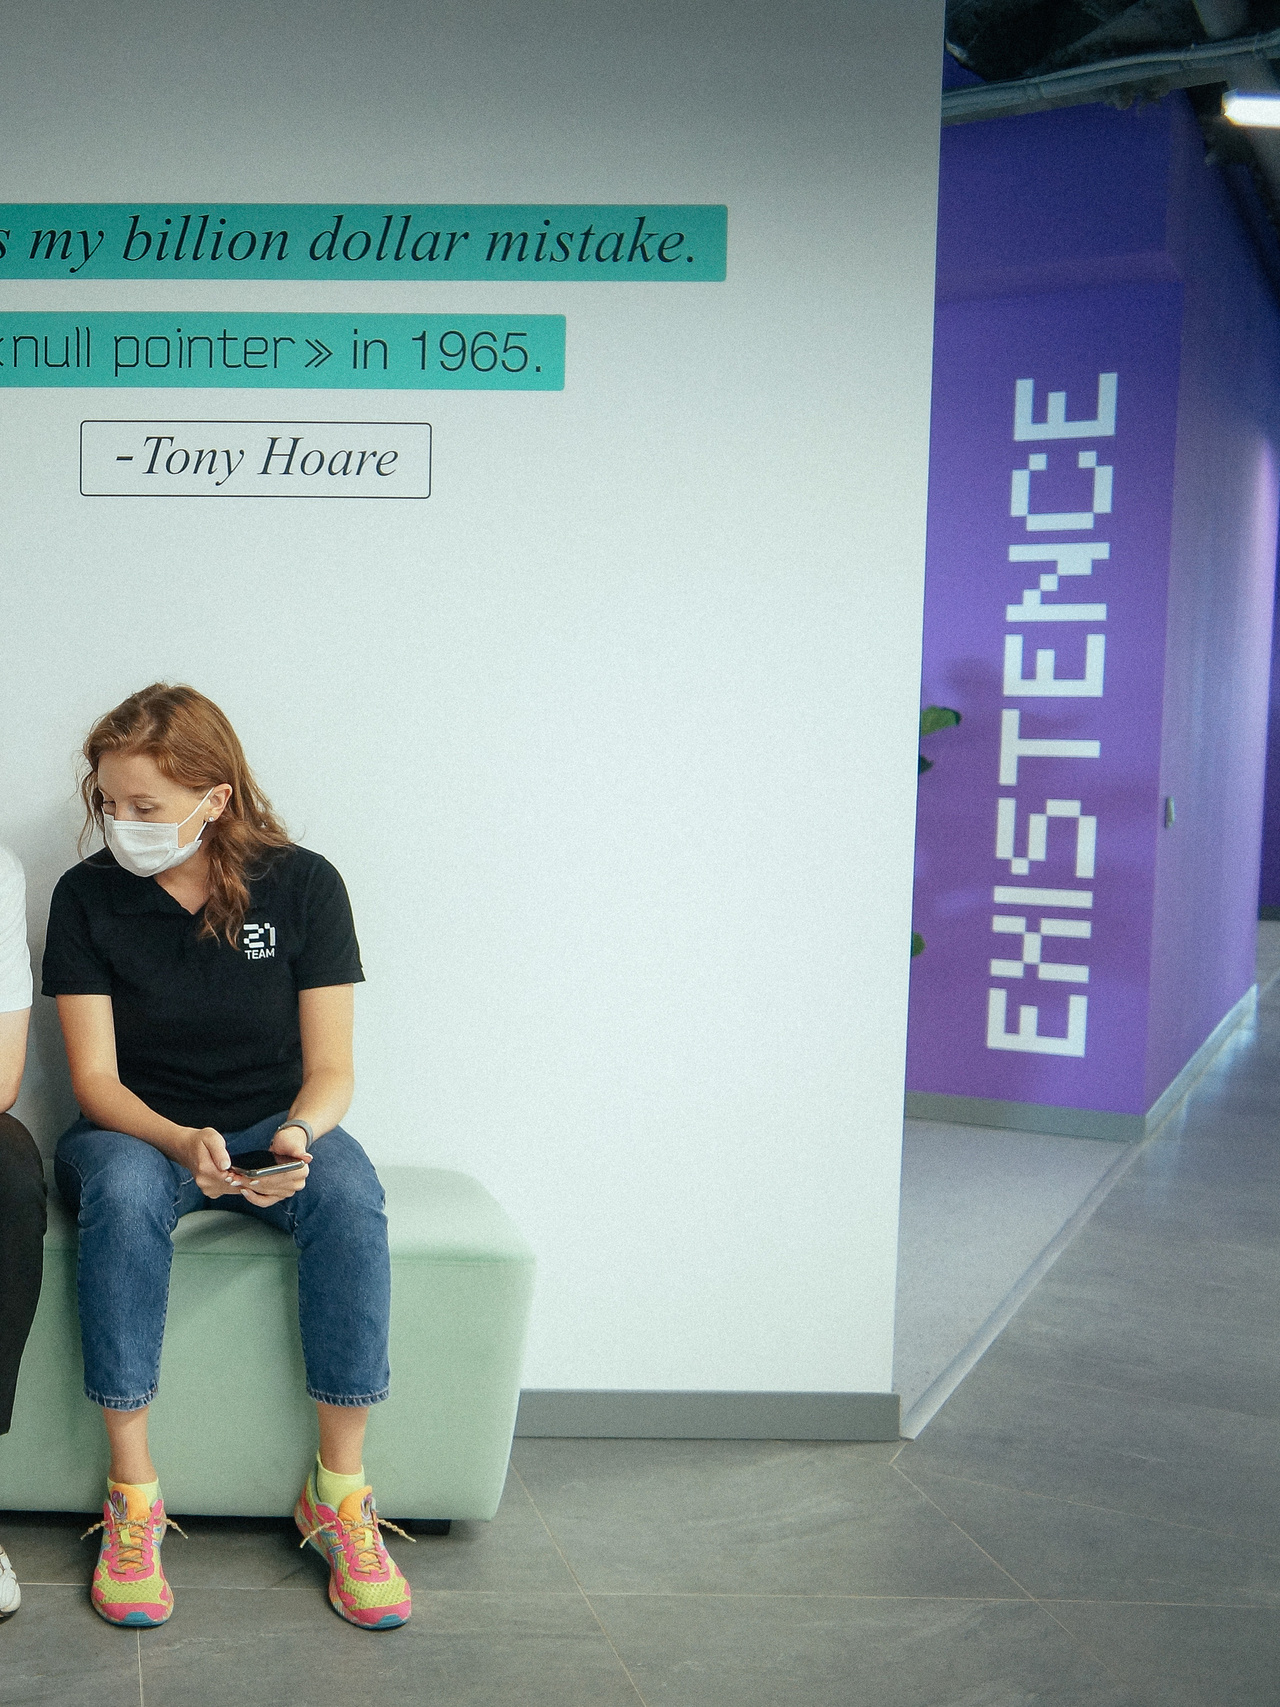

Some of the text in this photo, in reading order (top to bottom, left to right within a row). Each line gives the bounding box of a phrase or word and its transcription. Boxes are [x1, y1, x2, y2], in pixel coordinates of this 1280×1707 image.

[29, 229, 105, 274] my
[122, 214, 289, 262] billion
[309, 214, 470, 262] dollar
[485, 216, 696, 263] mistake.
[352, 328, 388, 370] in
[411, 330, 543, 374] 1965.
[260, 436, 399, 477] Hoare
[987, 372, 1118, 1058] EXISTENCE
[244, 947, 275, 960] TEAM
